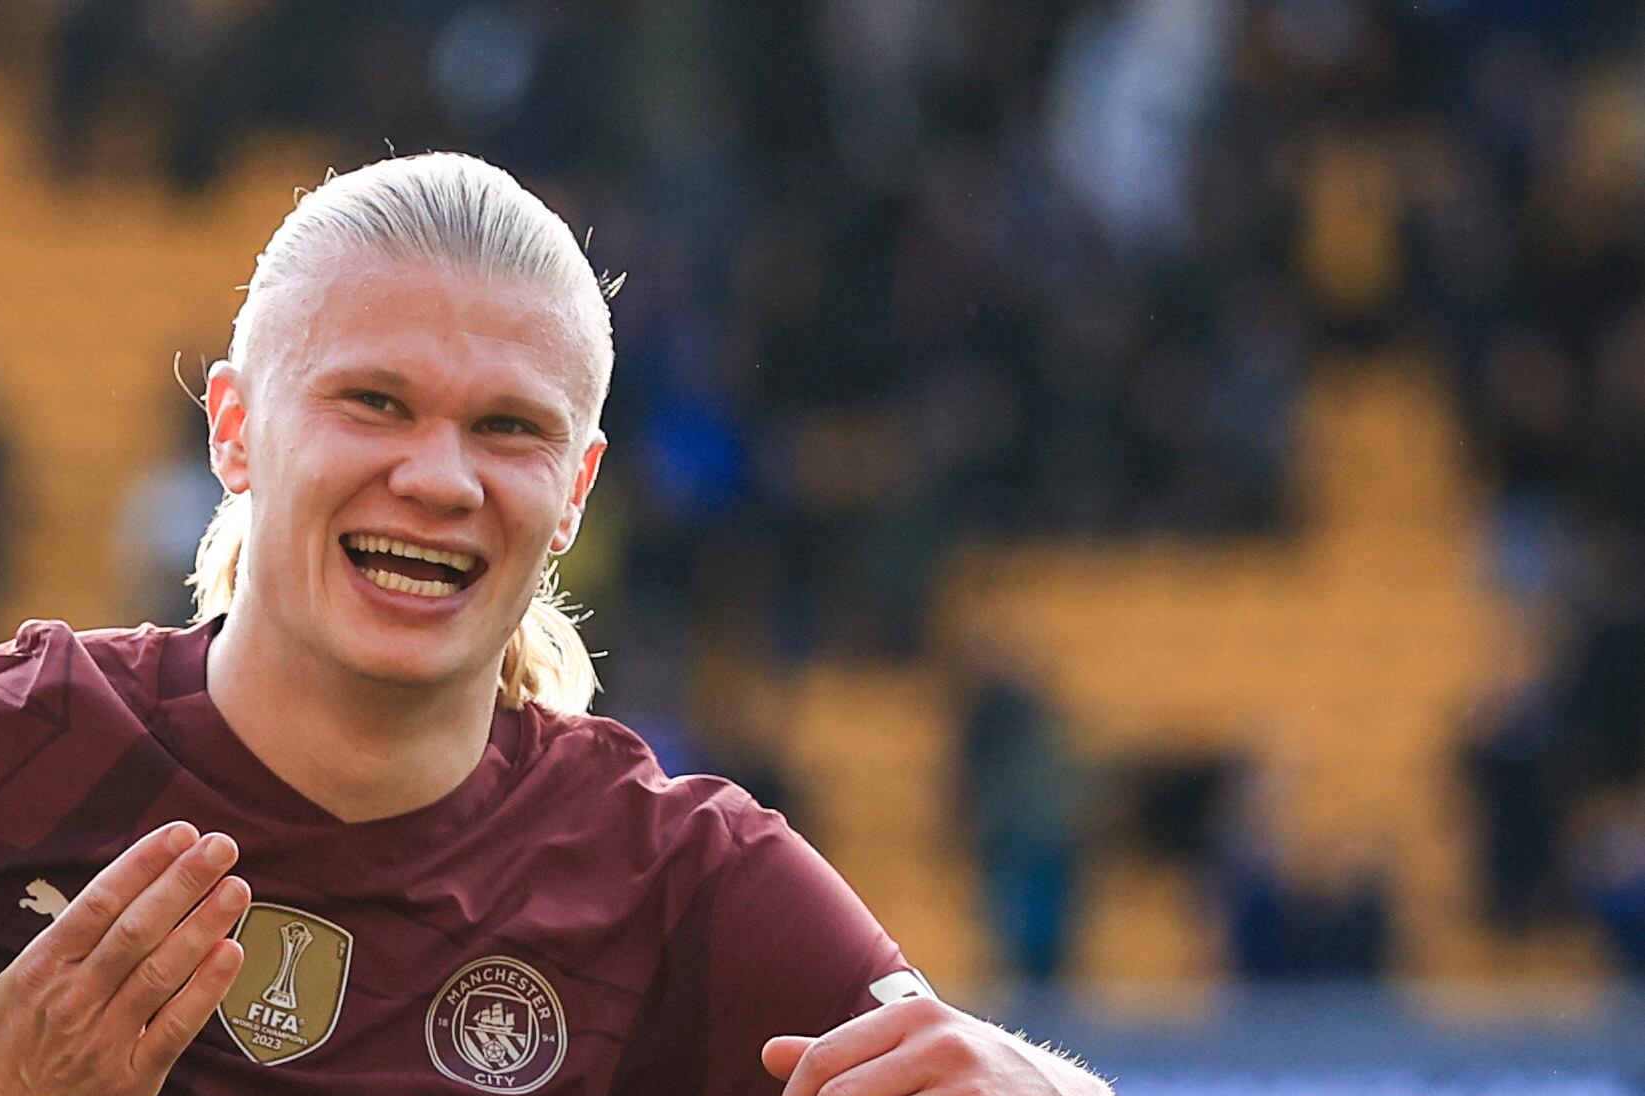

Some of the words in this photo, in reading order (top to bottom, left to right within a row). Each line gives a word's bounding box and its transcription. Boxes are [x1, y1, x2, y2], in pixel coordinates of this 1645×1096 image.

[446, 967, 552, 1020] MANCHESTER
[231, 1017, 260, 1031] WORLD
[247, 1002, 298, 1034] FIFA
[252, 1032, 282, 1050] 2023
[474, 1073, 516, 1087] CITY
